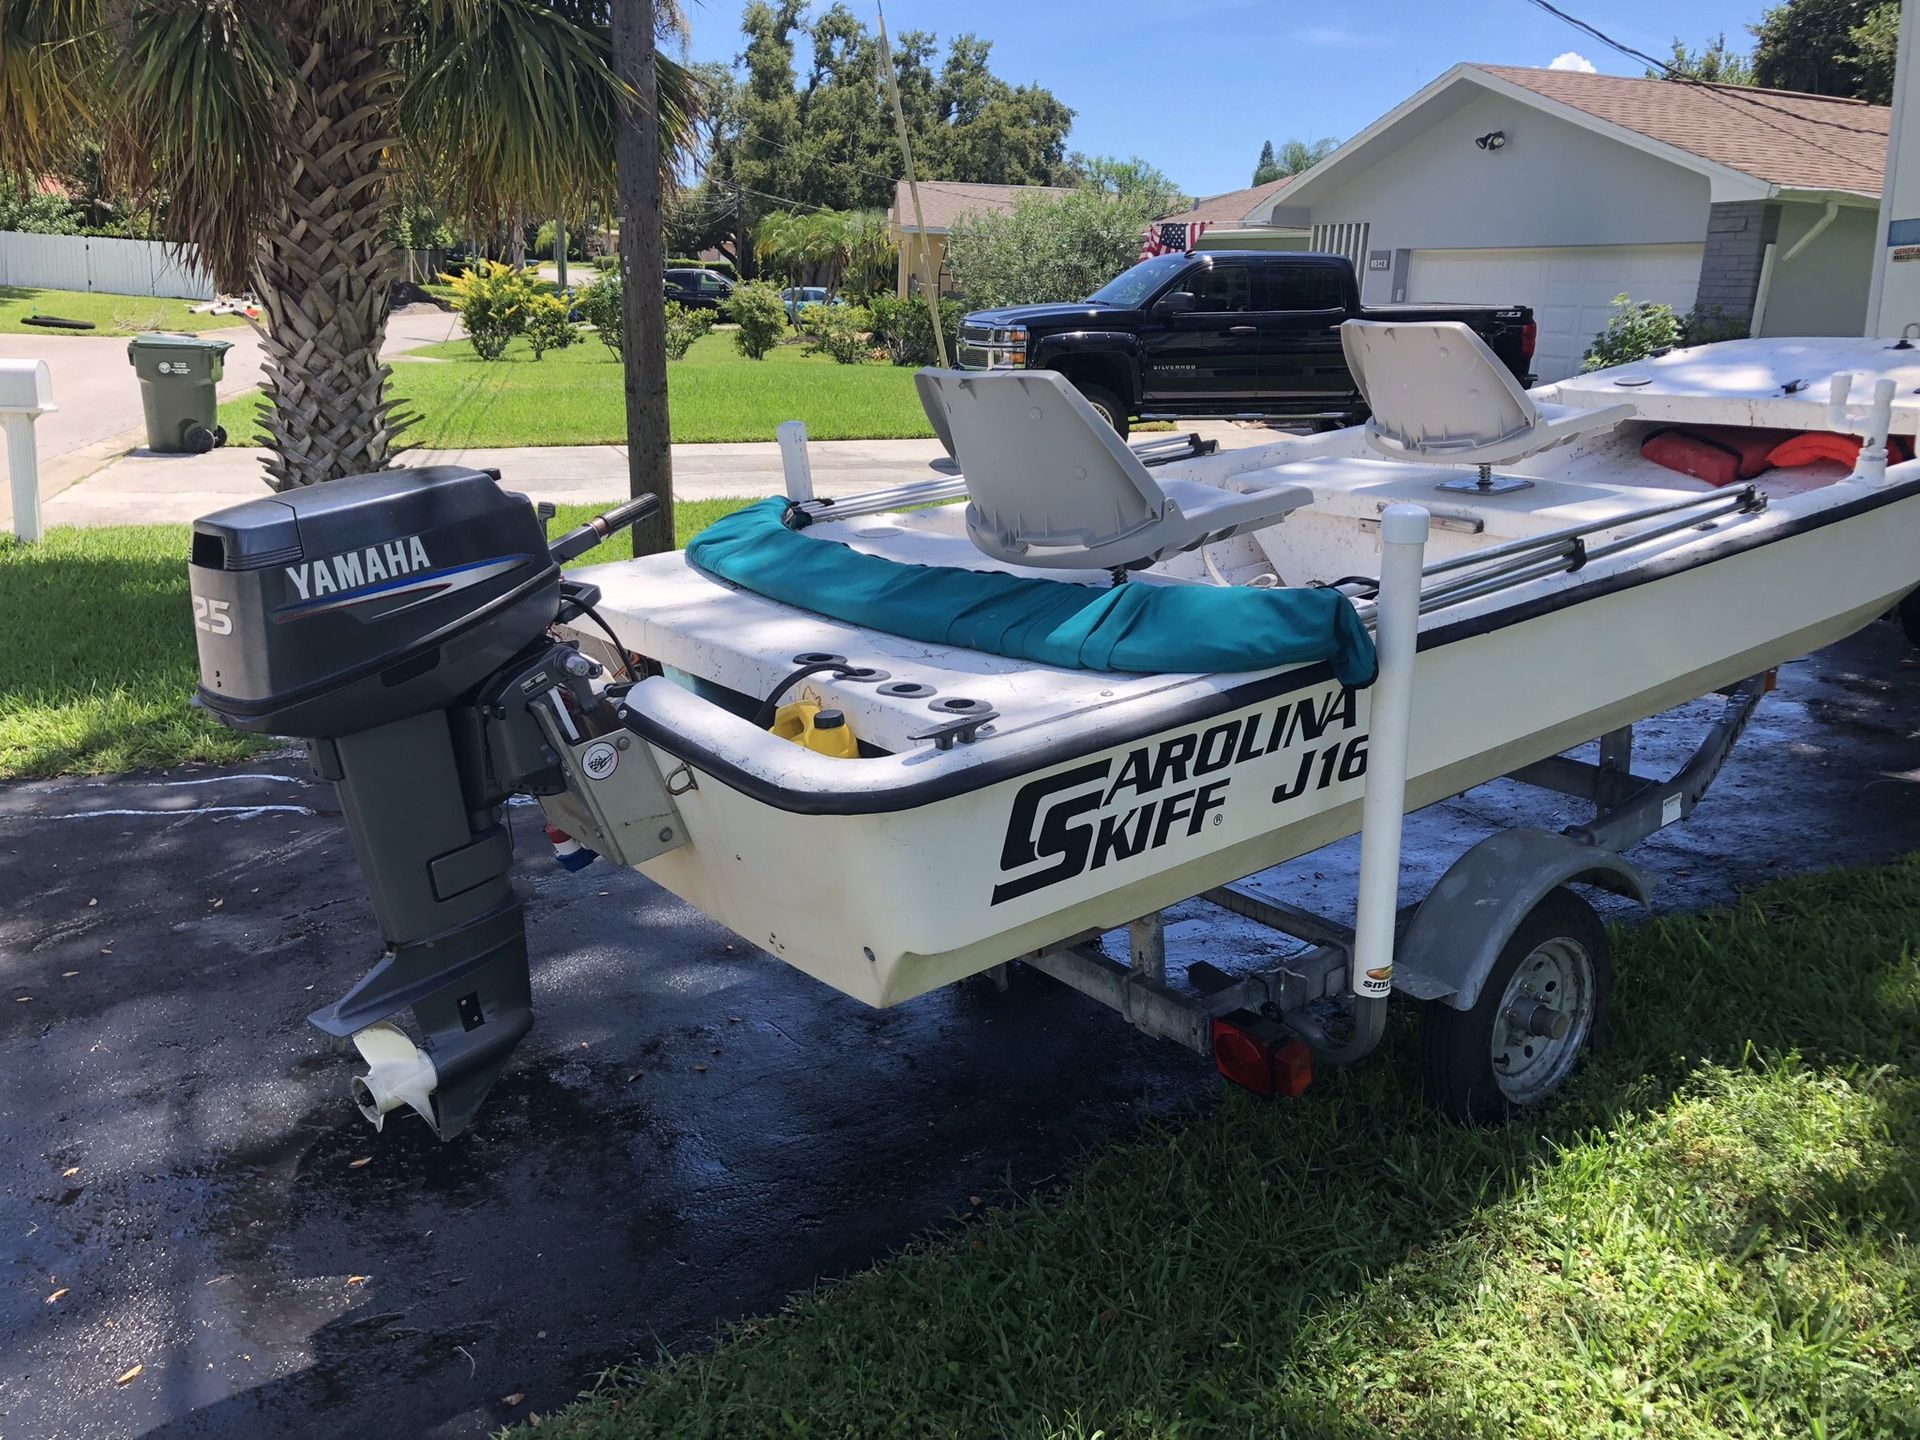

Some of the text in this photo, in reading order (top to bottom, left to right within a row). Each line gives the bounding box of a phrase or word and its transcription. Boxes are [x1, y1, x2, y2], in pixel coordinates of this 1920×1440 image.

[285, 535, 432, 600] YAMAHA
[193, 595, 233, 637] 25
[1000, 687, 1357, 871] CAROLINA
[1272, 734, 1369, 804] J16
